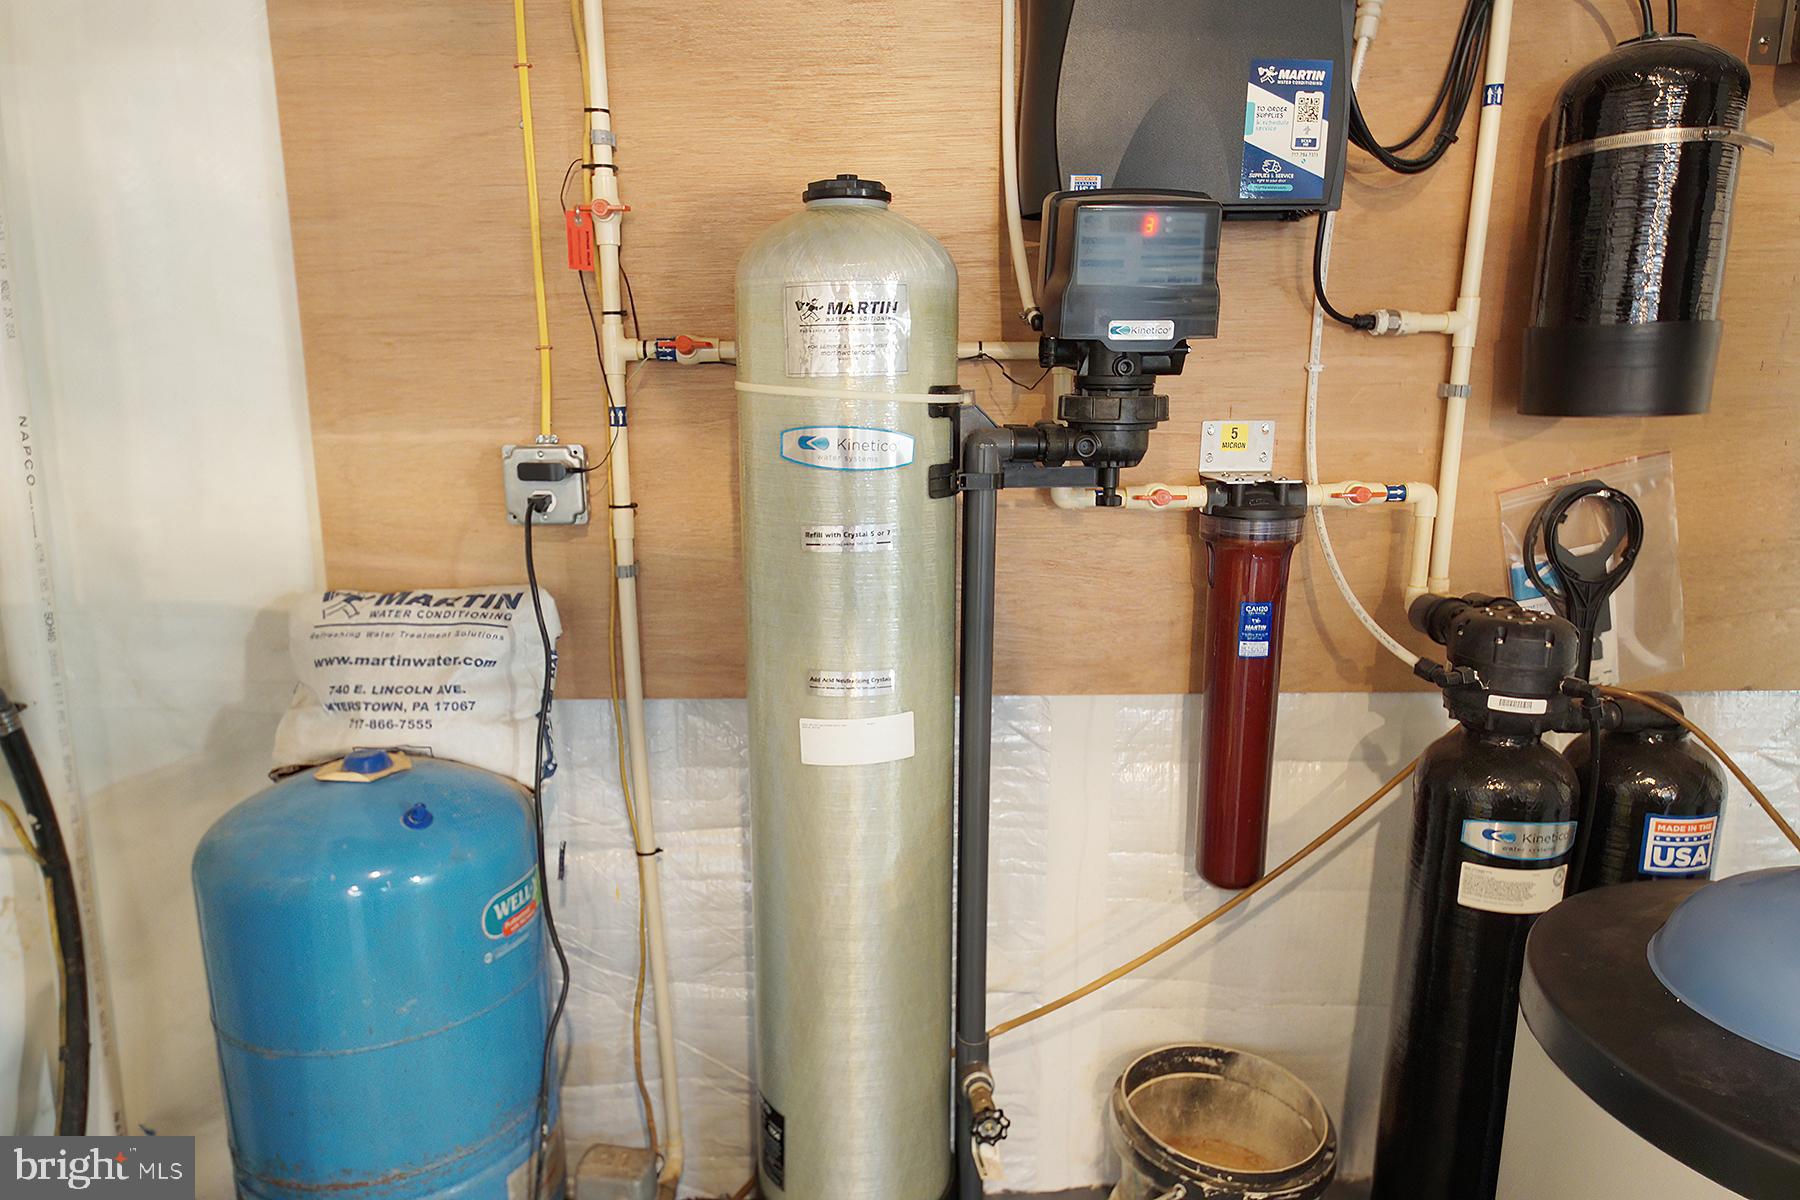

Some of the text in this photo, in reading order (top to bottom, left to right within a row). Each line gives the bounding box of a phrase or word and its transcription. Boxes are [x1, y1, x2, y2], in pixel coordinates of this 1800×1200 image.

[1278, 69, 1326, 81] MARTIN
[827, 301, 898, 315] MARTIN
[1131, 325, 1169, 335] Kinetico
[1231, 427, 1238, 439] 5
[18, 416, 36, 486] NAPCO
[837, 439, 897, 452] Kinetico
[844, 531, 868, 539] Crystal
[369, 609, 513, 621] WATER CONDITIONING
[400, 630, 451, 639] Treatment
[455, 630, 504, 641] Solutions
[314, 655, 497, 669] www.martinwater.com
[329, 684, 466, 695] 740 E. LINCOLN AVE.
[412, 702, 430, 711] PA
[435, 700, 477, 711] 17067
[1699, 822, 1712, 831] THE
[1653, 846, 1707, 867] USA
